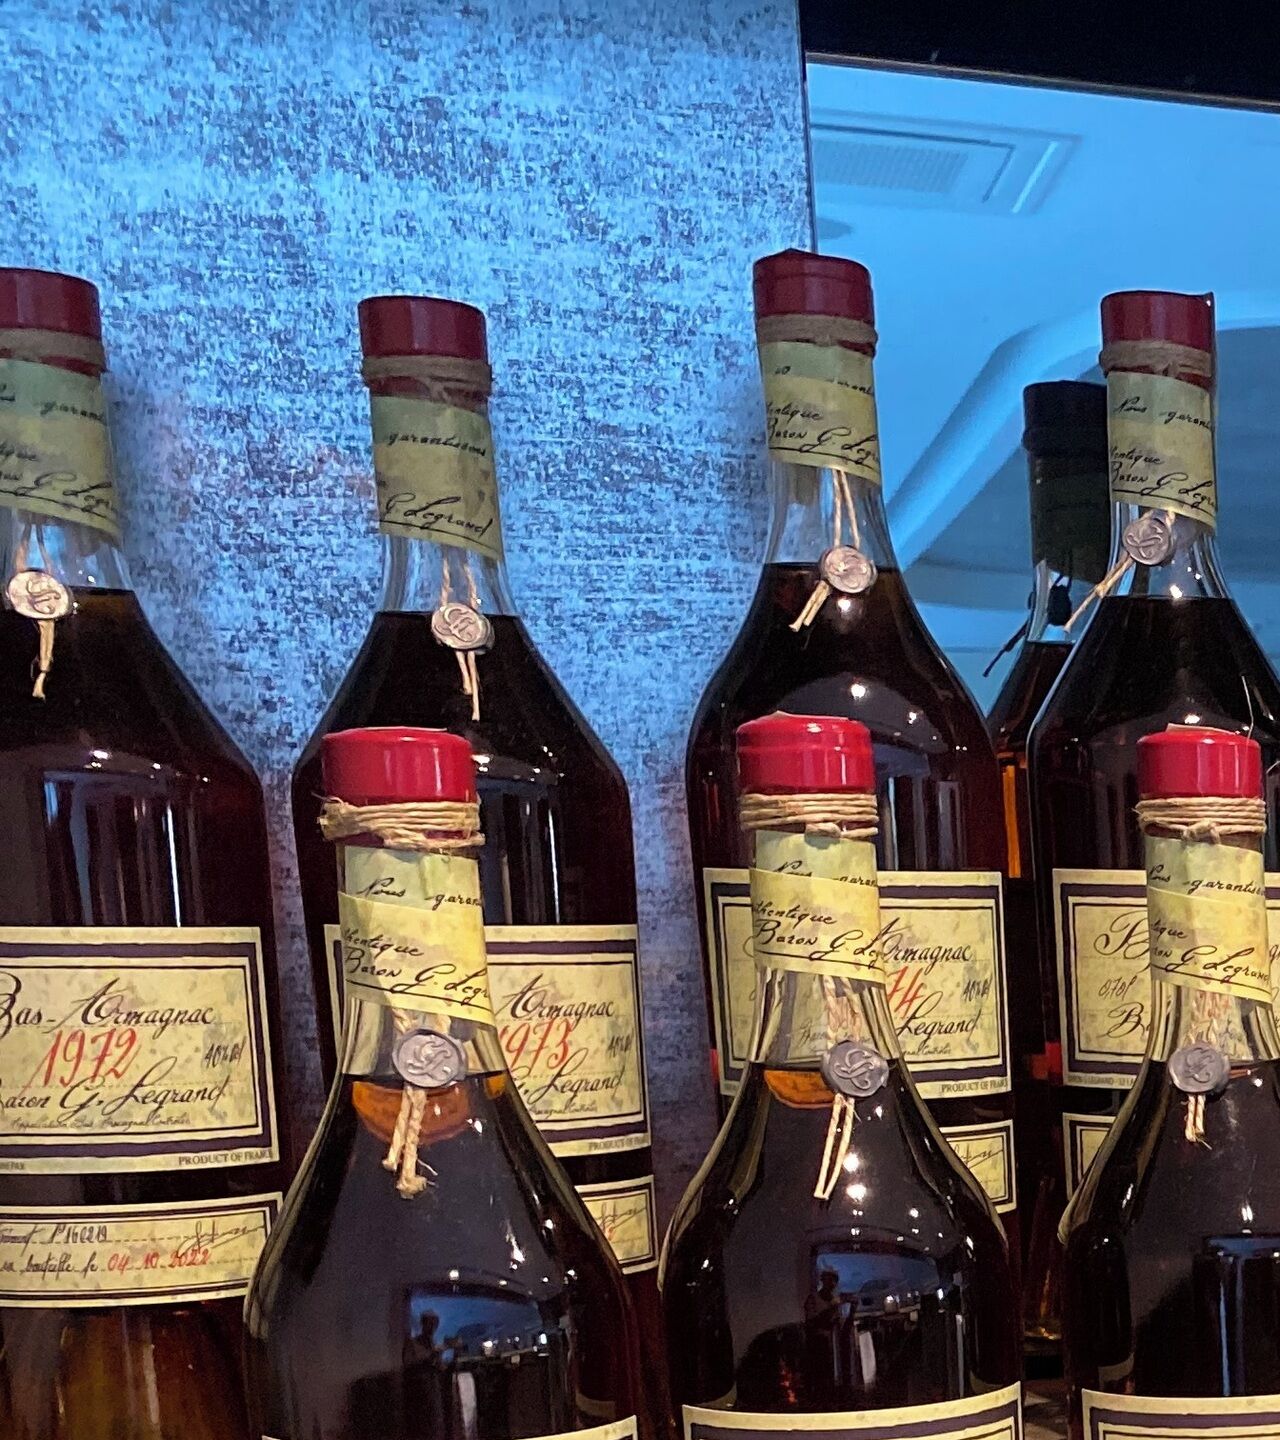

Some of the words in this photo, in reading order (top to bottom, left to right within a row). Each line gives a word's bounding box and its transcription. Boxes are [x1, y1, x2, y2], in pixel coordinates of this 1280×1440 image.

[754, 919, 818, 945] Baron
[344, 948, 401, 978] Baron
[894, 990, 982, 1045] Legrand
[32, 1027, 138, 1088] 1972
[0, 1080, 51, 1109] aron
[102, 1056, 230, 1116] Legrand
[941, 1080, 978, 1094] PRODUCT
[980, 1080, 989, 1090] OF
[178, 1152, 229, 1167] PRODUCT
[230, 1152, 243, 1164] OF
[107, 1257, 129, 1272] 04
